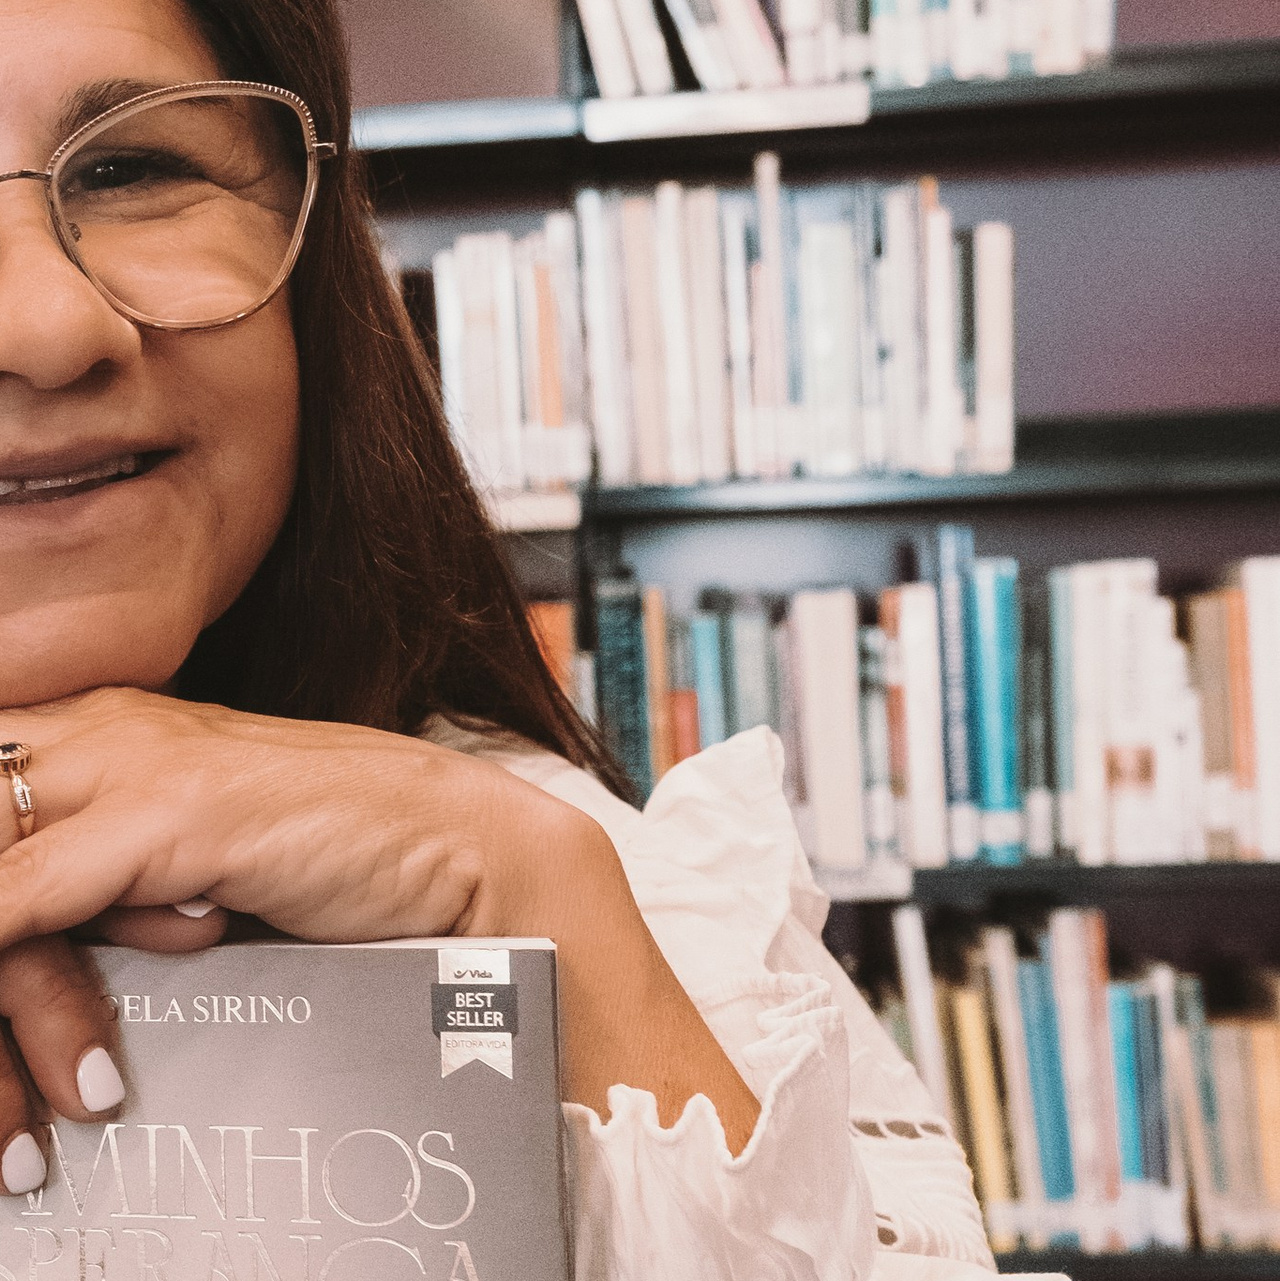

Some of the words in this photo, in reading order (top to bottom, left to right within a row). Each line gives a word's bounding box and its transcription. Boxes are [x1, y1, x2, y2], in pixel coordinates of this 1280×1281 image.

[469, 969, 493, 978] Vida
[455, 992, 494, 1008] BEST
[192, 995, 312, 1024] SIRINO
[446, 1011, 504, 1027] SELLER
[445, 1040, 483, 1049] EDITORA
[487, 1040, 508, 1049] VIDA
